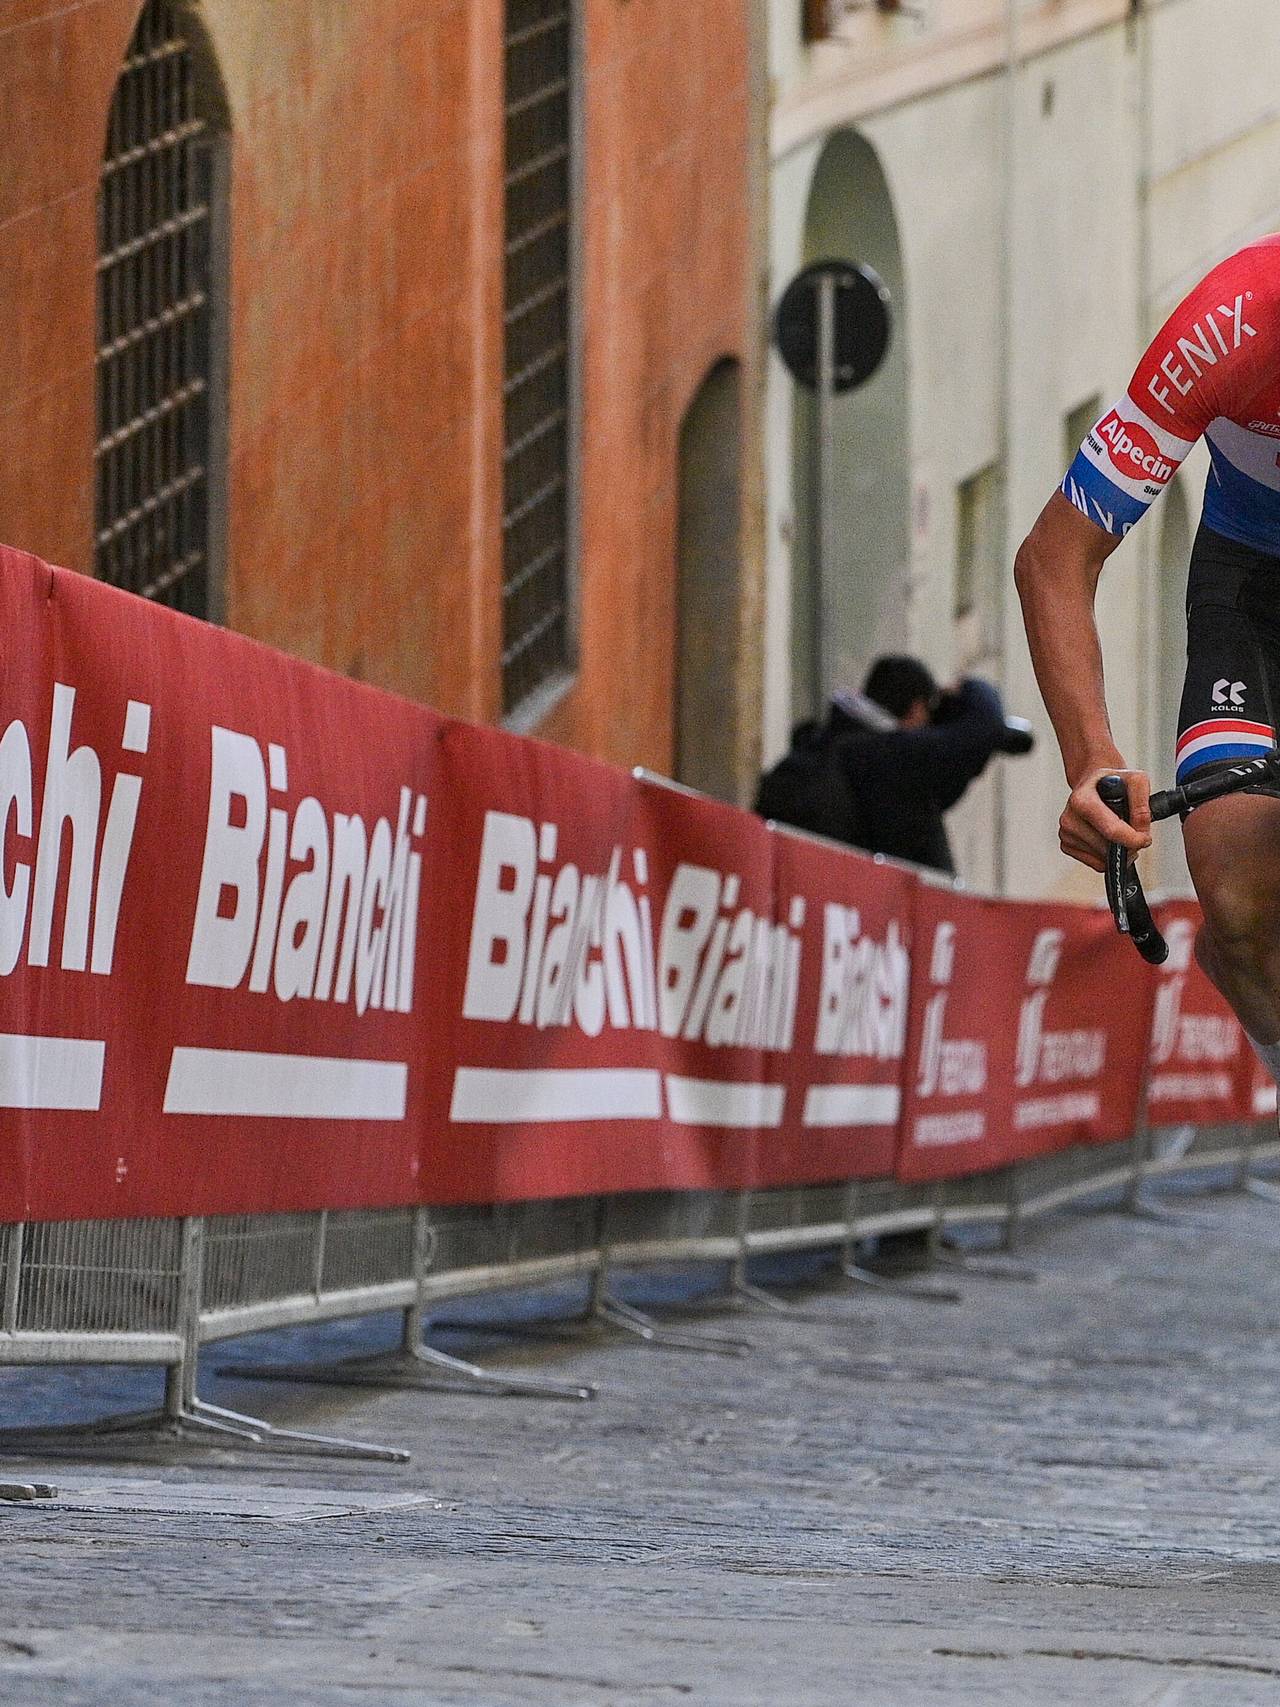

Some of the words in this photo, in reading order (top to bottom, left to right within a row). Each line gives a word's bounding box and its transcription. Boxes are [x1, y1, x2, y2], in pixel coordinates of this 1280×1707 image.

[1147, 294, 1257, 415] FENIX
[1101, 418, 1173, 480] Alpecin
[185, 724, 428, 1017] Bianchi
